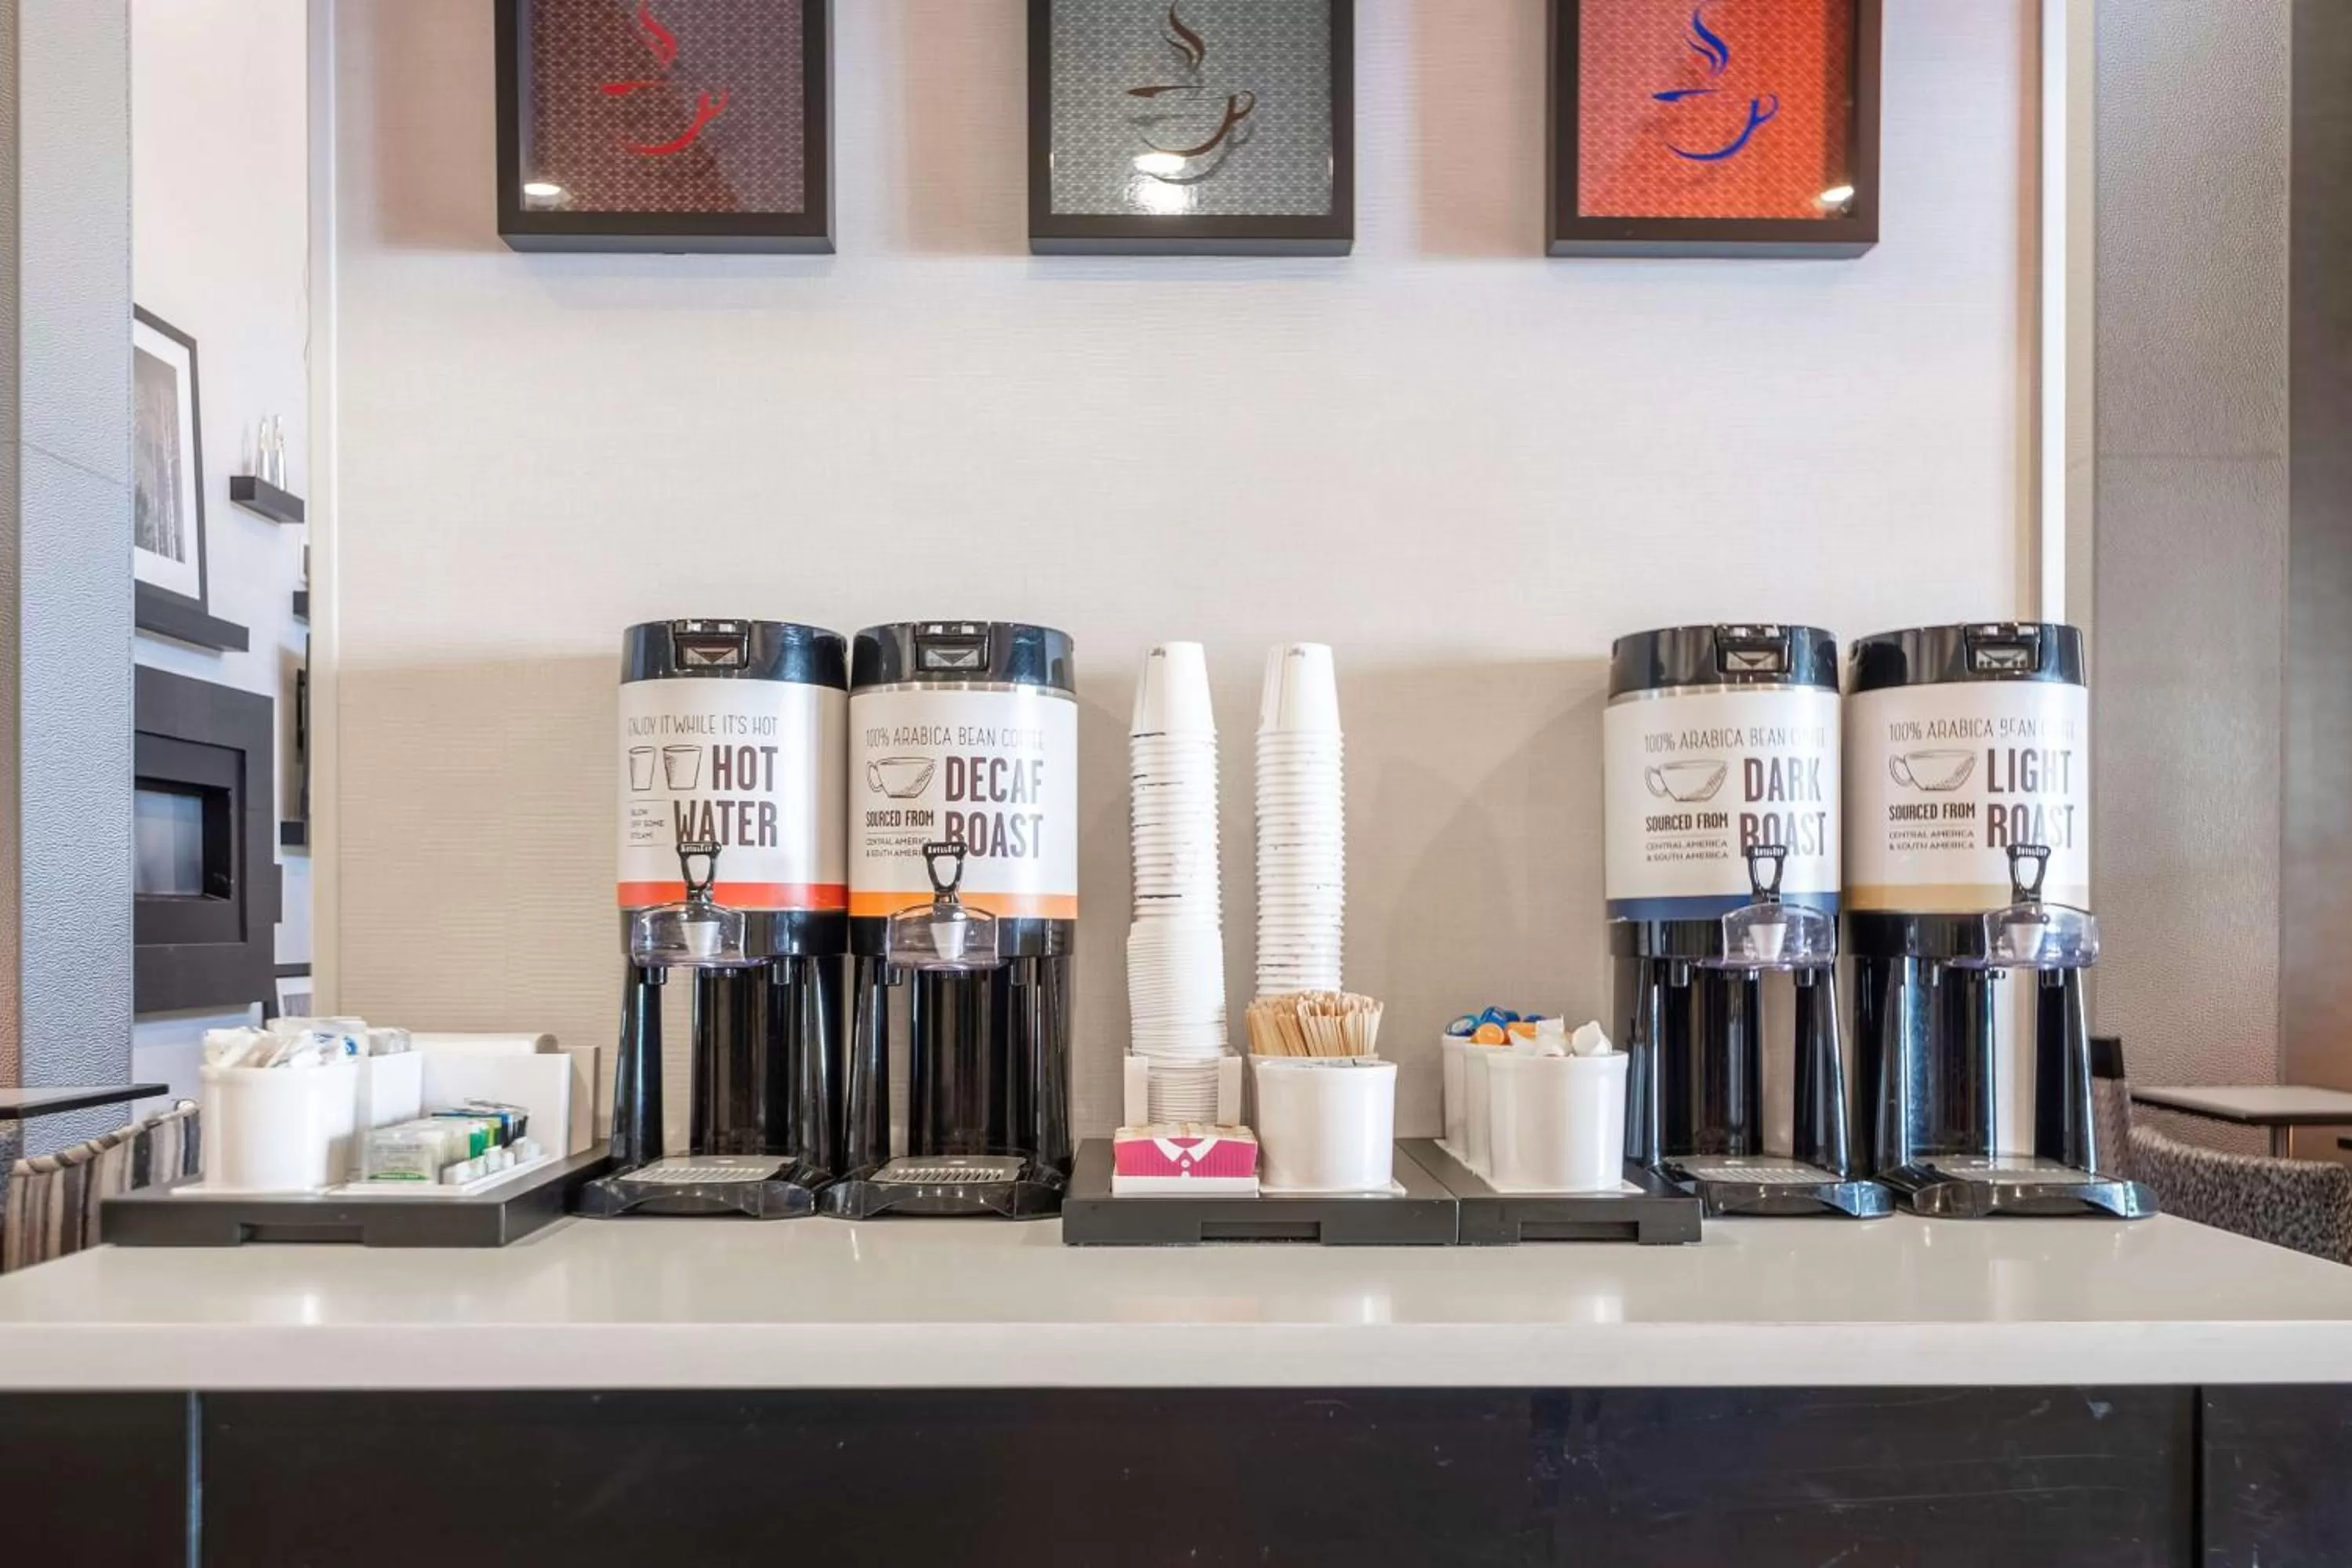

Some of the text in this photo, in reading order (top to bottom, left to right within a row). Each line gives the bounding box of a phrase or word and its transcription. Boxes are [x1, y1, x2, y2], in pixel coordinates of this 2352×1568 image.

[660, 714, 671, 734] IT
[673, 714, 716, 735] WHILE
[722, 714, 747, 735] IT'S
[752, 716, 779, 736] HOT
[893, 725, 952, 747] ARABICA
[958, 726, 996, 747] BEAN
[1889, 721, 1922, 742] 100%
[1926, 717, 1994, 741] ARABICA
[1644, 731, 1675, 753] 100%
[1679, 728, 1744, 750] ARABICA
[1749, 727, 1785, 747] BEAN
[713, 745, 779, 792] HOT
[946, 756, 1044, 804] DECAF
[1744, 756, 1821, 802] DARK
[1987, 748, 2073, 793] LIGHT
[673, 800, 778, 847] WATER
[866, 809, 934, 828] SOURCED FROM
[1646, 811, 1729, 833] SOURCED FROM
[1889, 803, 1976, 822] SOURCED FROM
[945, 811, 1044, 858] ROAST
[1740, 811, 1826, 857] ROAST
[1889, 829, 1974, 840] CENTRAL AMERICA
[1987, 803, 2074, 849] ROAST
[895, 848, 924, 858] AMERI
[1646, 839, 1729, 851] CENTRAL AMERICA
